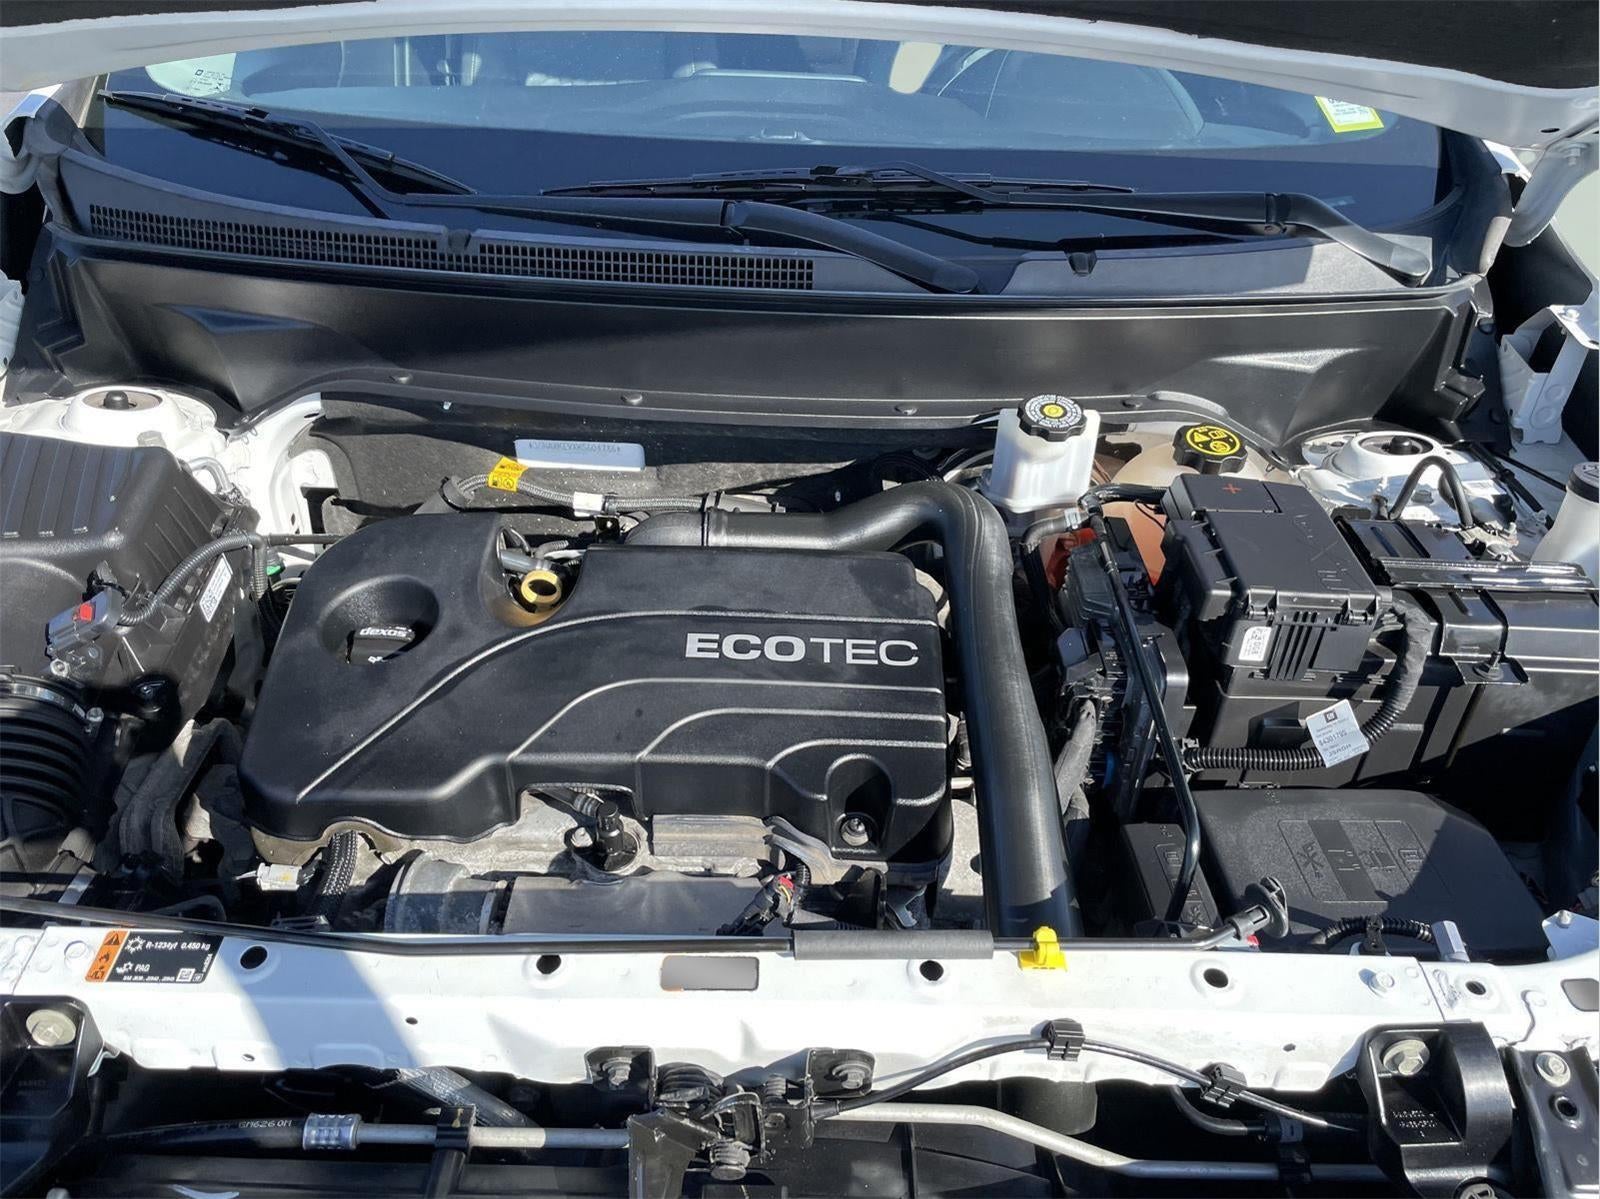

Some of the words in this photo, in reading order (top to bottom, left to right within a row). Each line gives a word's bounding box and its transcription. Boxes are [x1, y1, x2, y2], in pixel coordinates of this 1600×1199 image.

[360, 627, 407, 637] dexos
[685, 633, 919, 667] ECOTEC
[145, 942, 178, 950] R-1234yf
[180, 942, 201, 950] 0.450
[201, 942, 211, 951] kg
